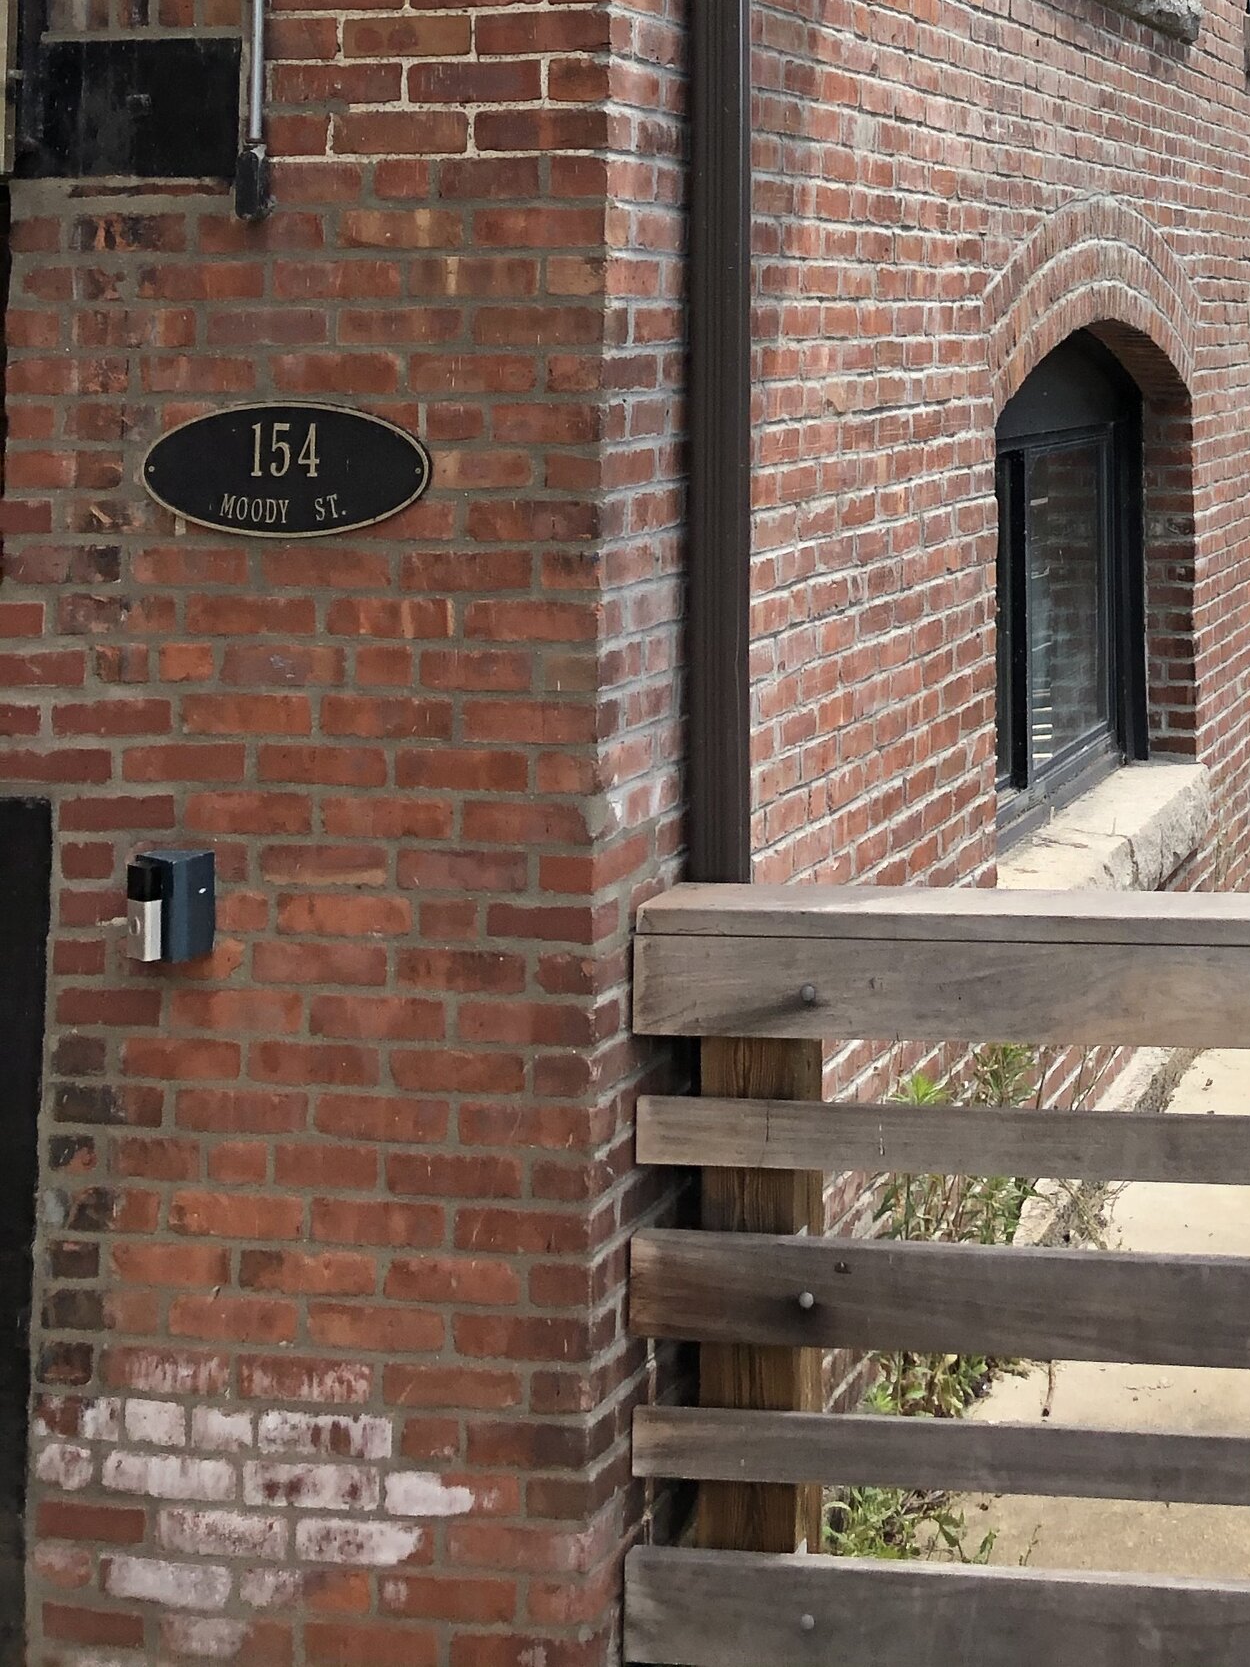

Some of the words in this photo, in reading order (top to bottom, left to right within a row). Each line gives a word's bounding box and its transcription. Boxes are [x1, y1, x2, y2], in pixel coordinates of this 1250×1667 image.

[250, 422, 320, 478] 154
[219, 493, 290, 524] MOODY
[314, 493, 347, 521] ST.
